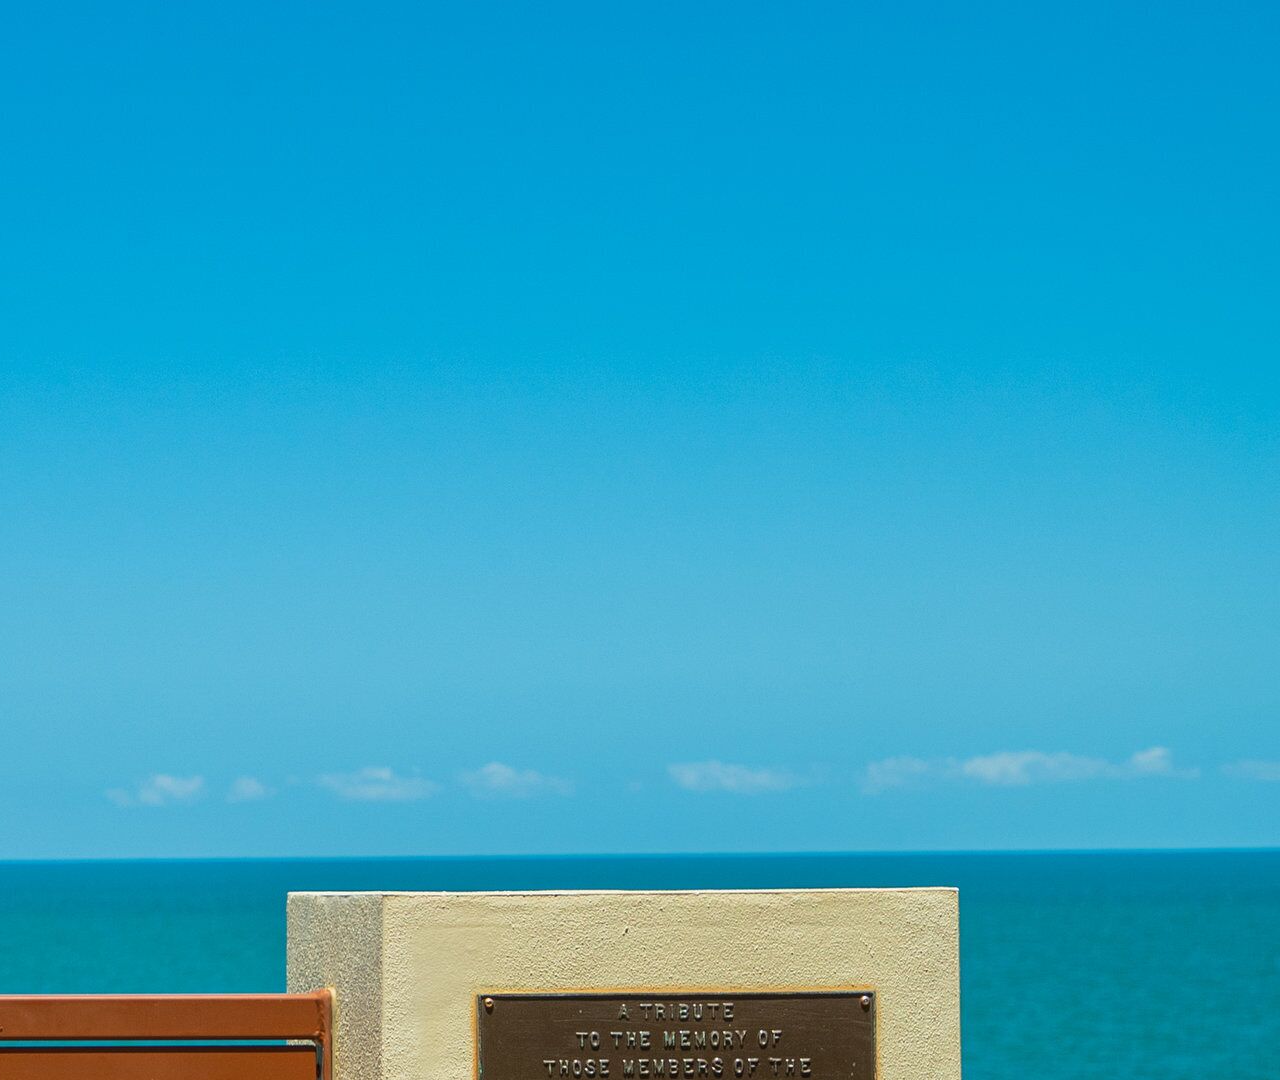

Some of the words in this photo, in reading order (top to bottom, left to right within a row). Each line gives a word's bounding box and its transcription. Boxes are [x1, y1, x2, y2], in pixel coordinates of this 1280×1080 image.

[618, 1004, 629, 1020] A
[639, 1003, 735, 1019] TRIBUTE
[576, 1032, 600, 1049] TO
[611, 1031, 650, 1048] THE
[664, 1030, 747, 1048] MEMORY
[759, 1030, 782, 1047] OF
[543, 1059, 609, 1077] THOSE
[623, 1058, 723, 1075] MEMBERS
[734, 1059, 759, 1074] OF
[769, 1058, 812, 1074] THE
